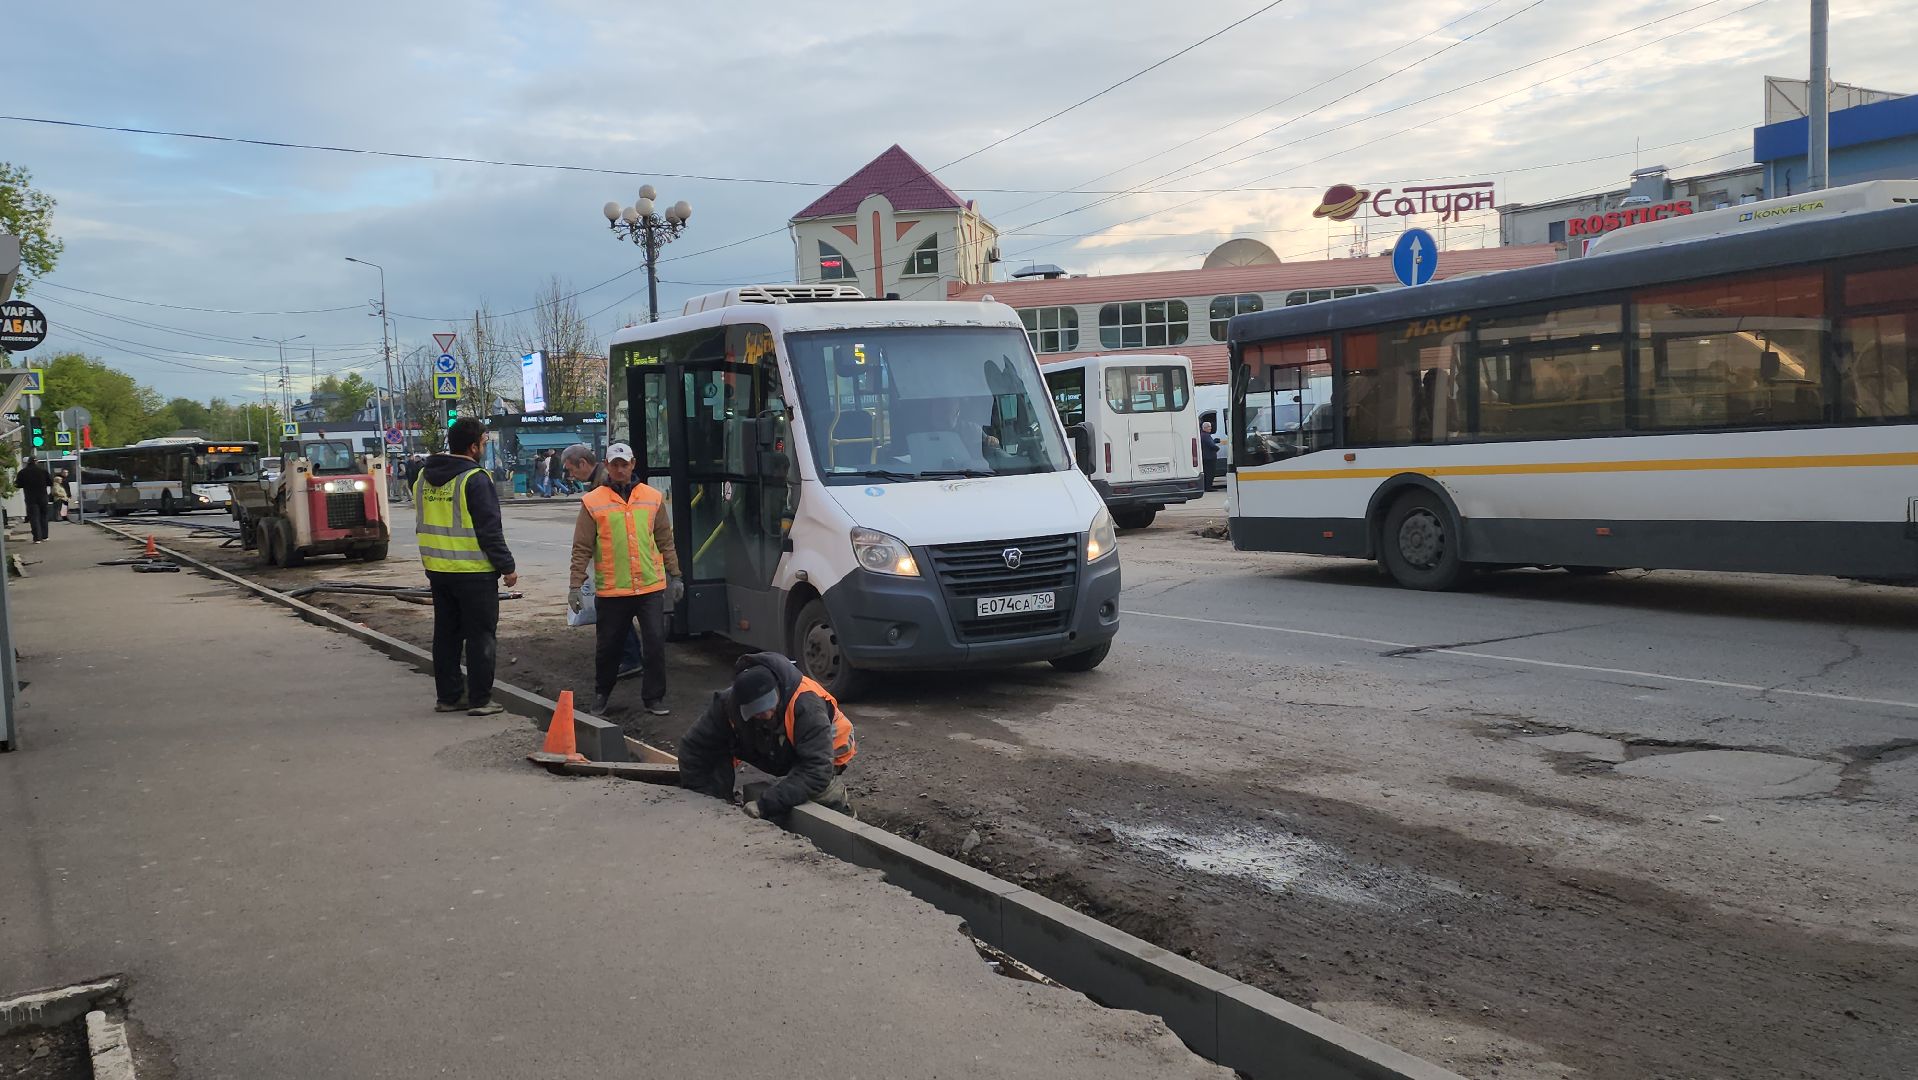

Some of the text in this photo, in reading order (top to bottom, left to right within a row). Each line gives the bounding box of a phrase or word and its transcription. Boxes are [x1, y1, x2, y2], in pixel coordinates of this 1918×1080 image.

[1568, 200, 1693, 236] ROSTIC'S
[1754, 202, 1825, 220] KONVEKTA
[1, 306, 35, 317] VAPE
[854, 343, 865, 365] 5
